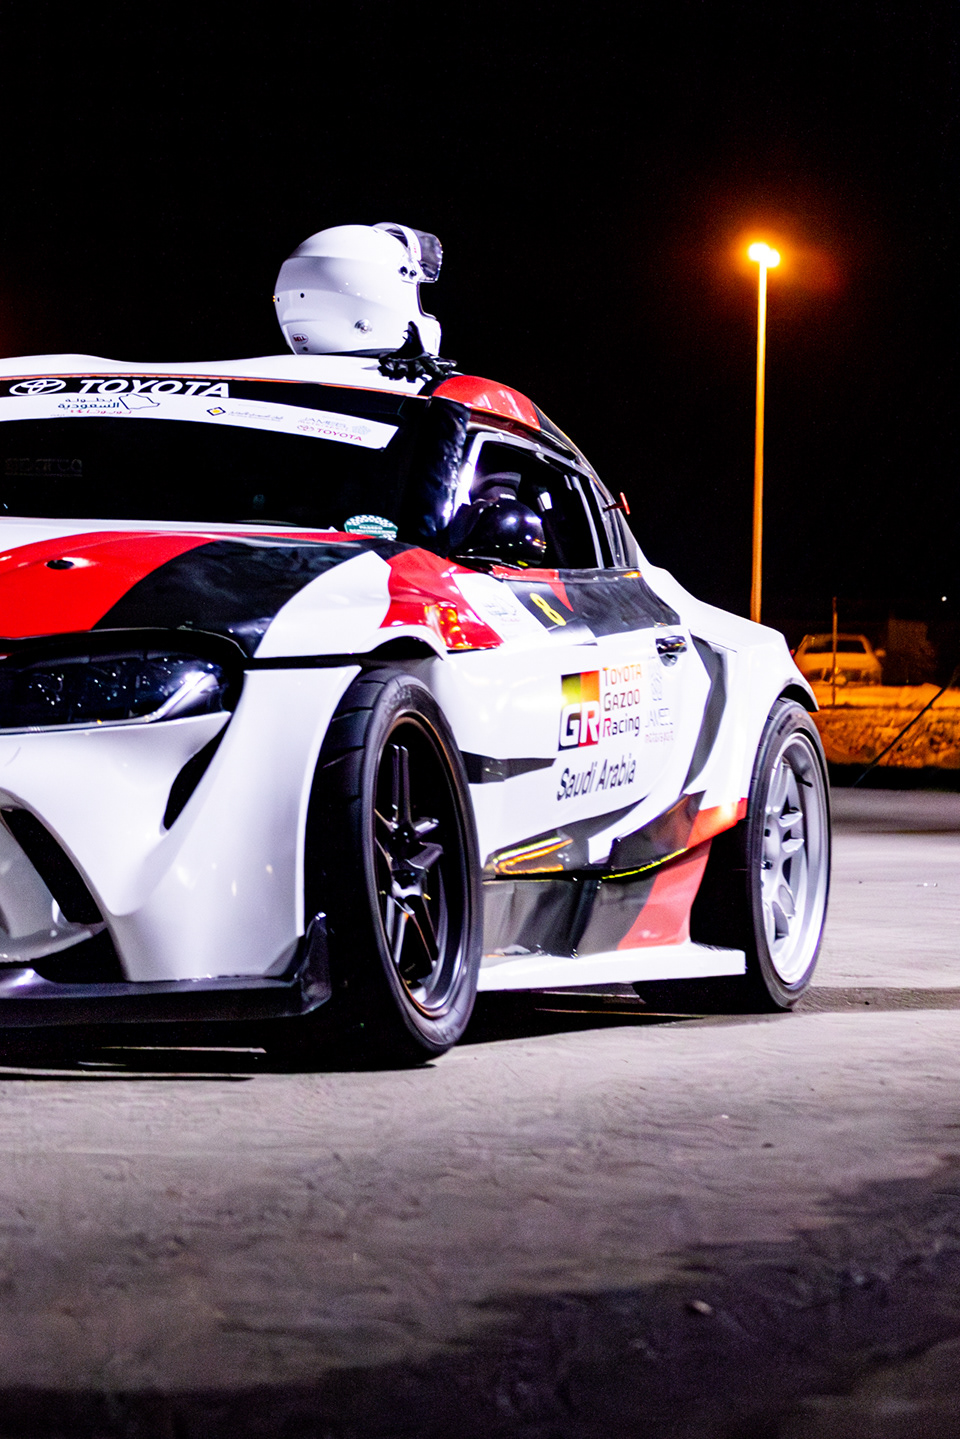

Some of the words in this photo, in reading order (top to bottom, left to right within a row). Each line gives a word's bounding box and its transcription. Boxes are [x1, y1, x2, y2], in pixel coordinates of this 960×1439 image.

[78, 379, 230, 398] TOYOTA
[318, 428, 362, 441] TOYOTA
[602, 664, 642, 686] TOYOTA
[603, 689, 640, 712] GAZOO
[560, 701, 600, 747] GR
[602, 713, 640, 737] Racing
[557, 760, 598, 802] Saudi
[595, 753, 636, 791] Arabia
